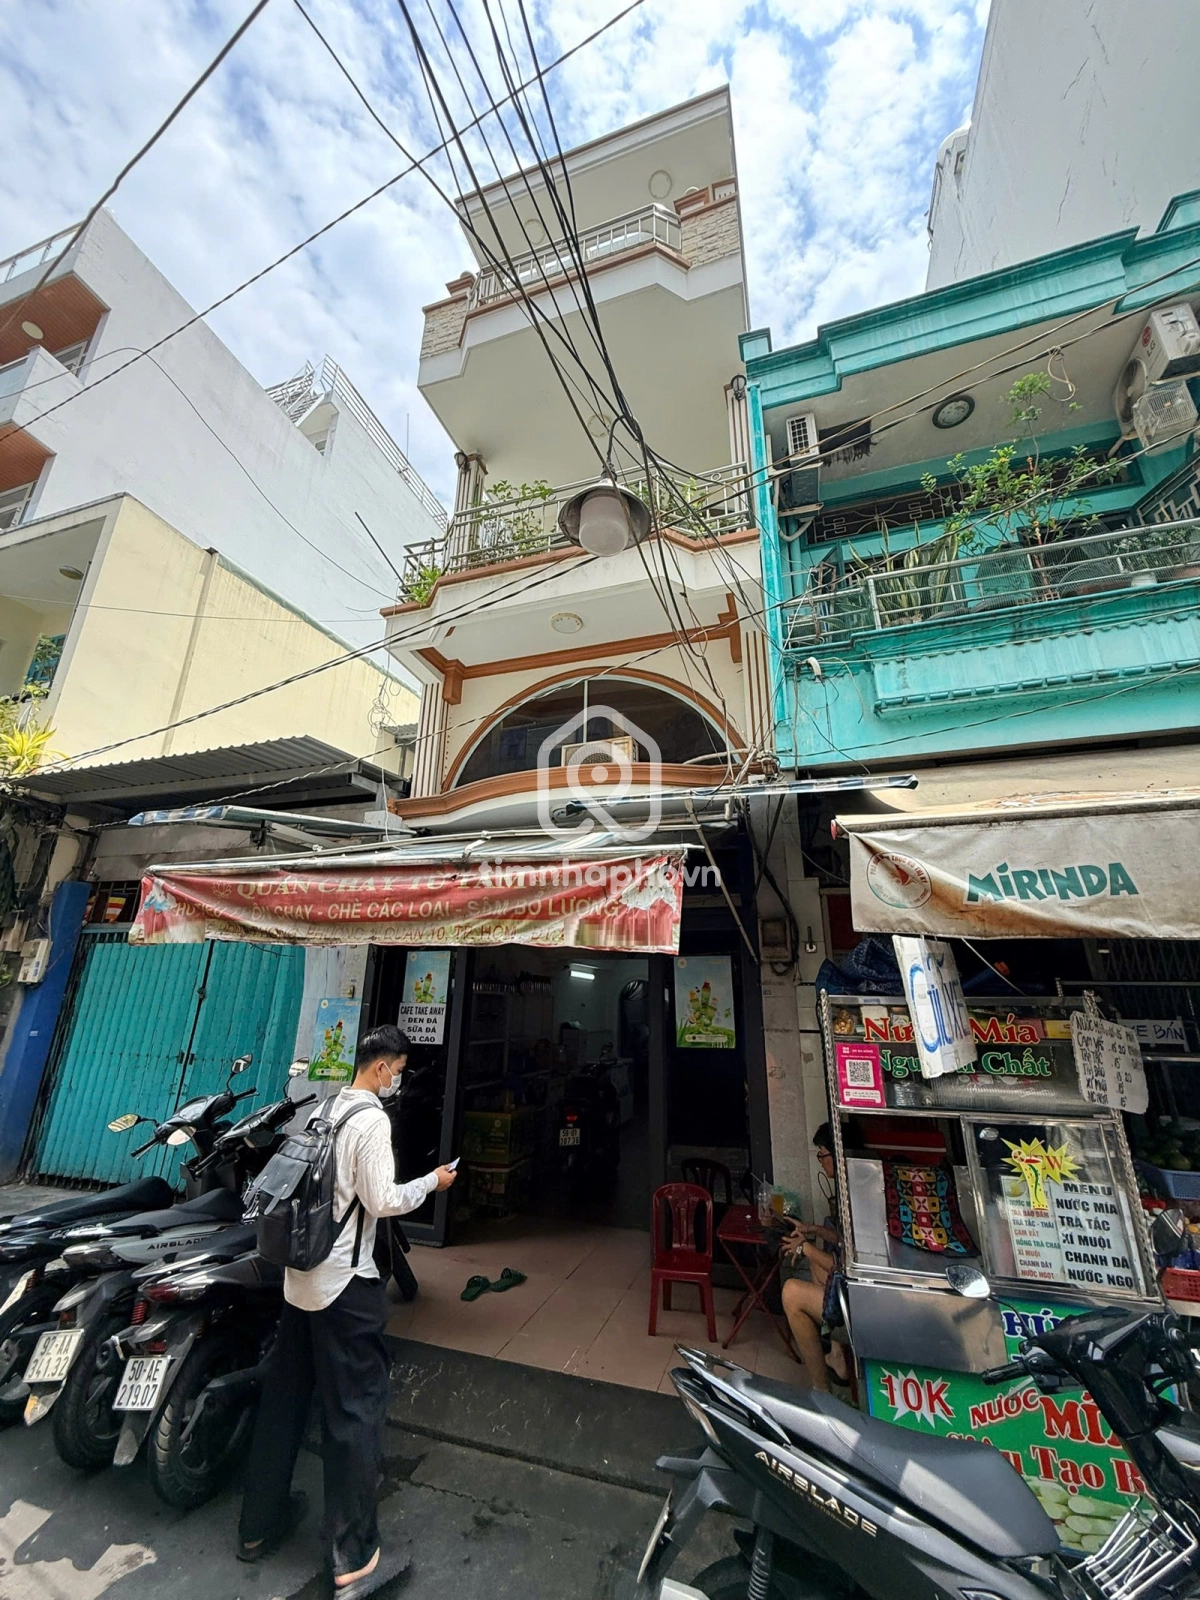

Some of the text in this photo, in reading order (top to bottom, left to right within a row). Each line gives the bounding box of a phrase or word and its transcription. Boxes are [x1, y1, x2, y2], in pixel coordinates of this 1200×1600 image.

[1147, 340, 1156, 357] LG
[237, 875, 311, 899] QUÁN
[317, 876, 398, 893] CHAY
[274, 904, 313, 921] CHAY
[327, 898, 361, 919] CHÈ
[366, 898, 402, 918] CÁC
[408, 900, 450, 922] LOẠI
[401, 1006, 445, 1016] CAFE TAKE AWAY
[1153, 1021, 1185, 1041] BÁN
[981, 1047, 1052, 1076] Chất
[1063, 1182, 1113, 1197] MENU
[1056, 1198, 1118, 1216] NƯỚC MÍA
[1058, 1215, 1084, 1229] TRÀ
[1078, 1234, 1112, 1251] MUỘI
[1065, 1250, 1131, 1270] CHANH DÂ
[1067, 1268, 1134, 1290] NƯỚC NGỌ
[28, 1356, 70, 1379] 341.32
[116, 1384, 159, 1407] 219.07
[880, 1373, 955, 1418] 10K
[1029, 1445, 1105, 1495] Tạo
[754, 1450, 878, 1538] AIRBLADE
